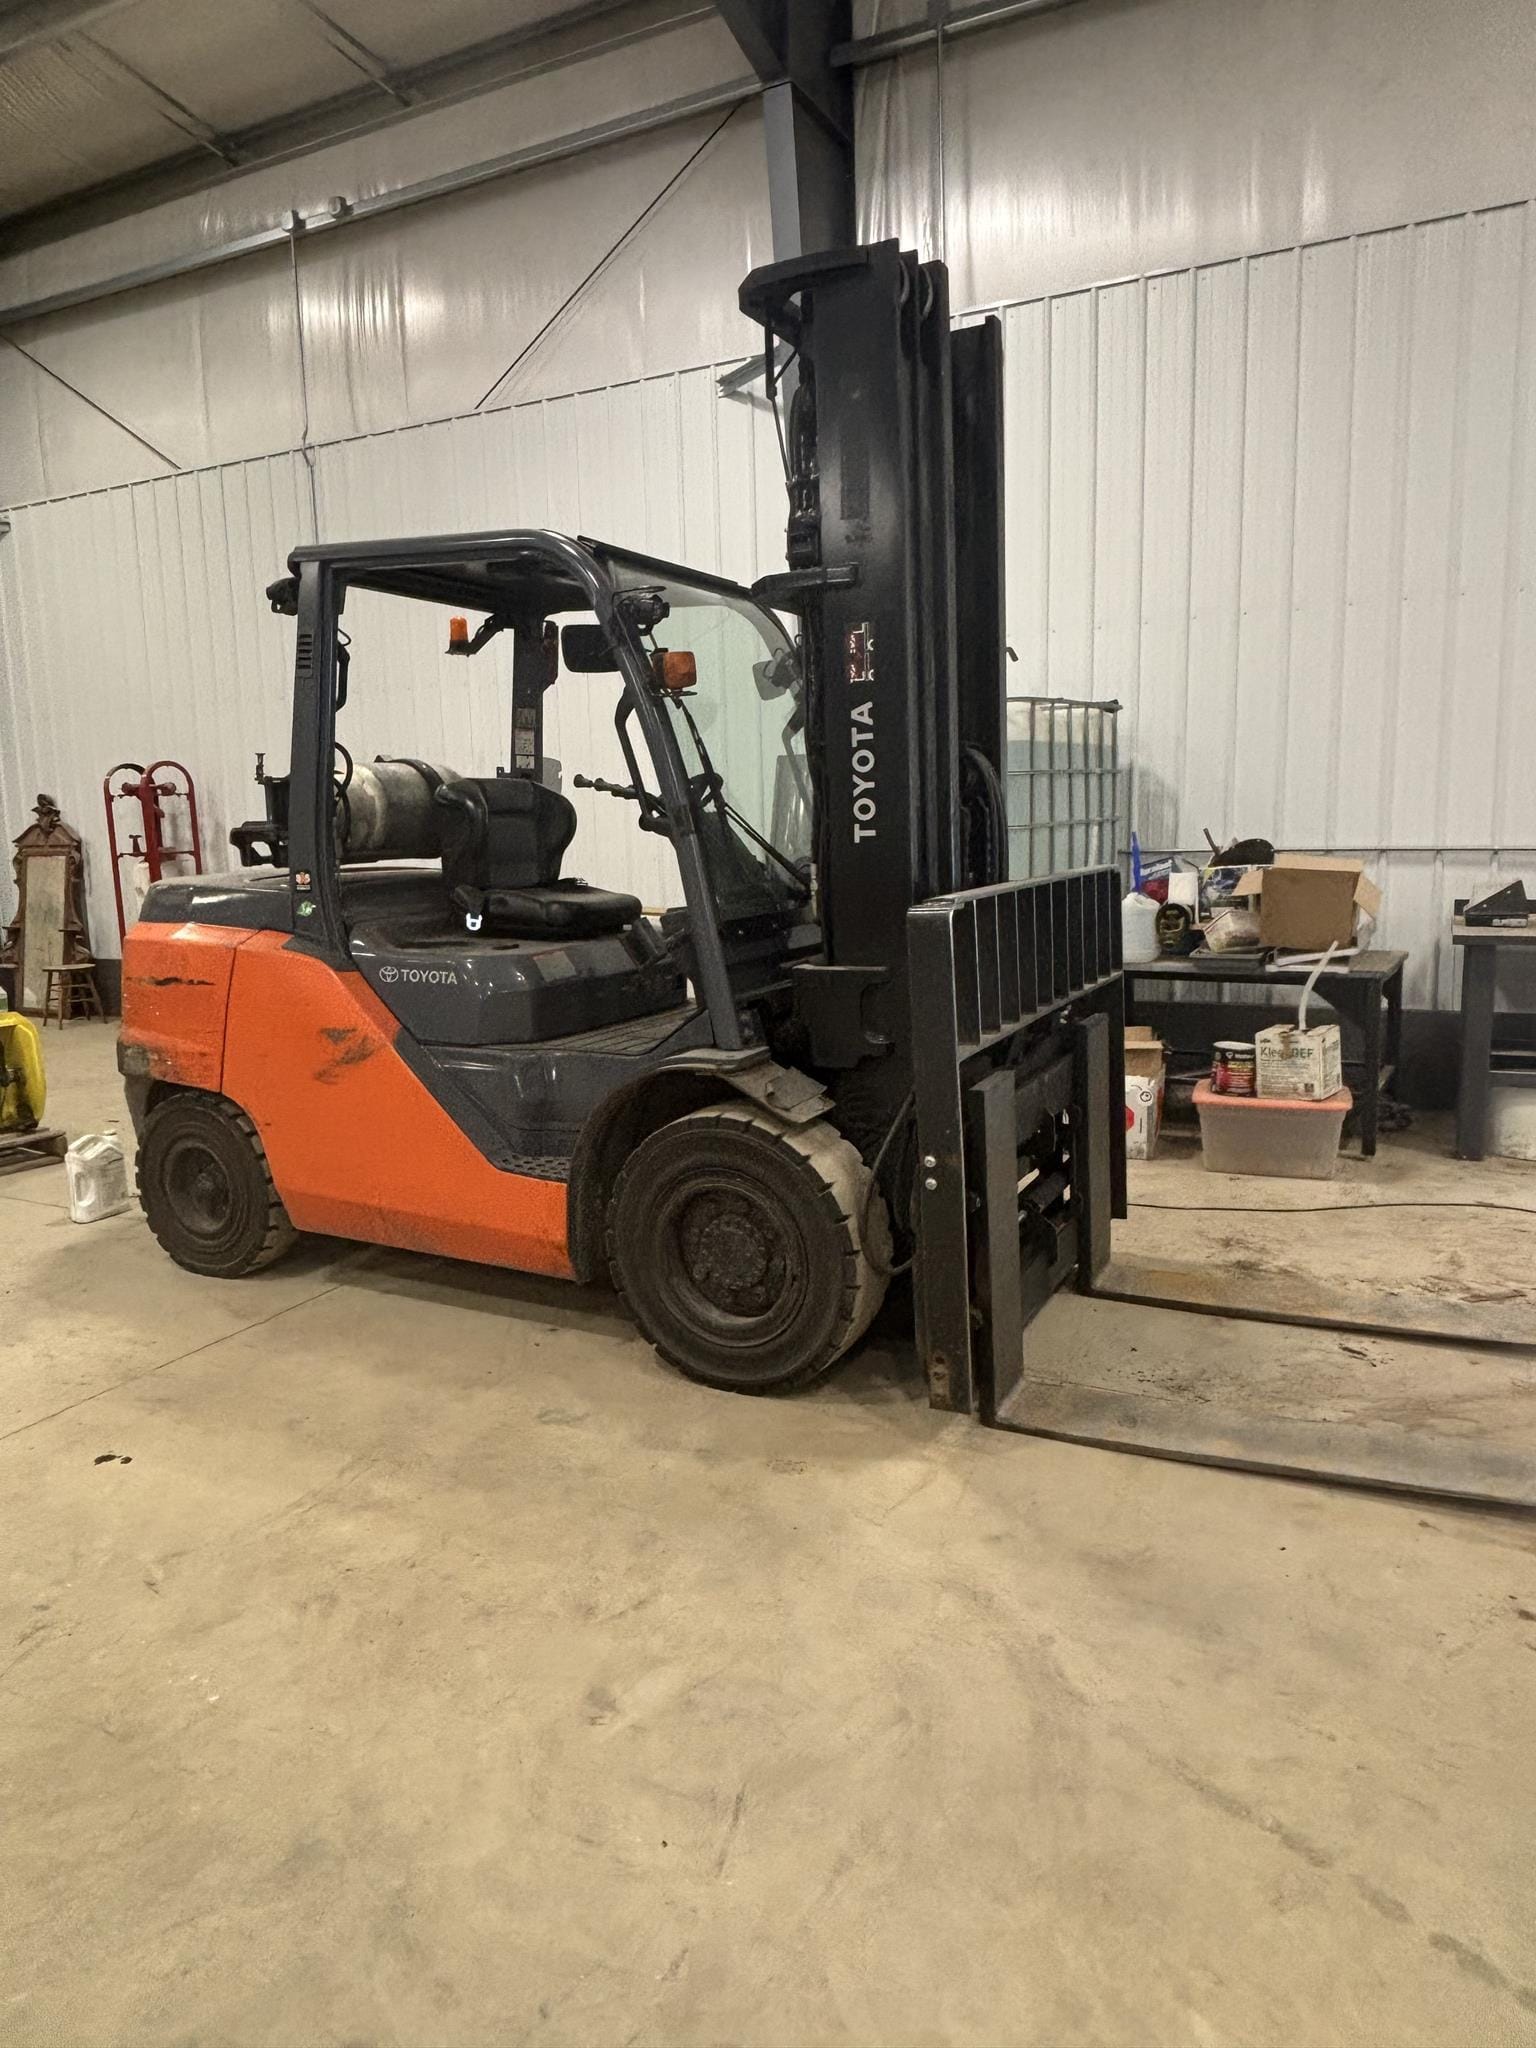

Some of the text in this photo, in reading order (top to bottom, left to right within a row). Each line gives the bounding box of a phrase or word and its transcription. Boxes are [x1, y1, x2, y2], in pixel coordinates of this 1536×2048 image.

[850, 701, 877, 844] TOYOTA
[401, 969, 458, 985] TOYOTA
[1260, 1046, 1288, 1058] Klee
[1291, 1047, 1315, 1059] DEF
